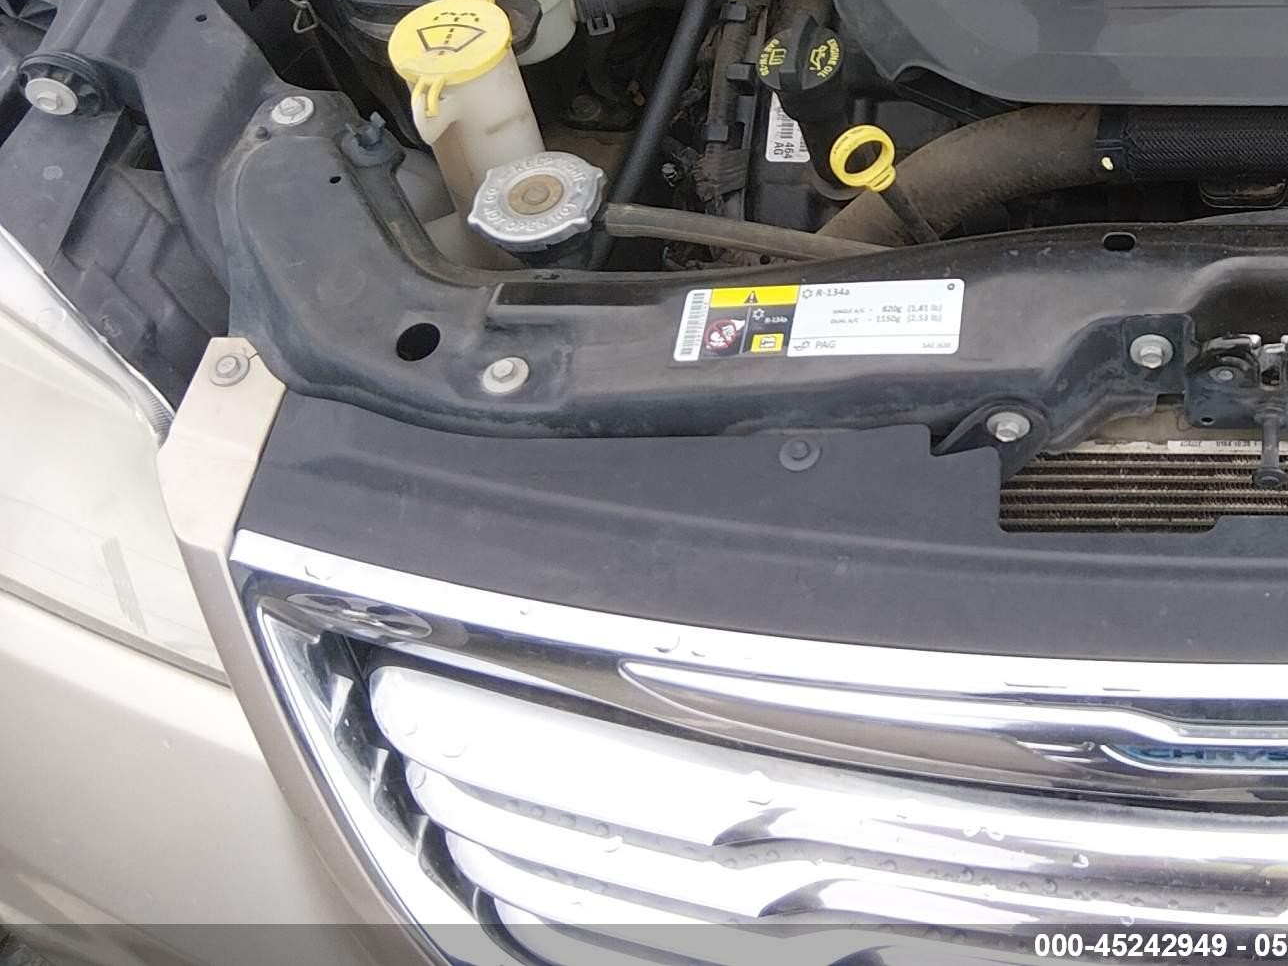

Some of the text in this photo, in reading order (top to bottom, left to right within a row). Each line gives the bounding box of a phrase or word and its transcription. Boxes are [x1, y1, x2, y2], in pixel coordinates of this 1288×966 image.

[817, 38, 841, 78] ENGINE OIL
[815, 286, 850, 297] R-134a
[815, 340, 836, 350] PAG
